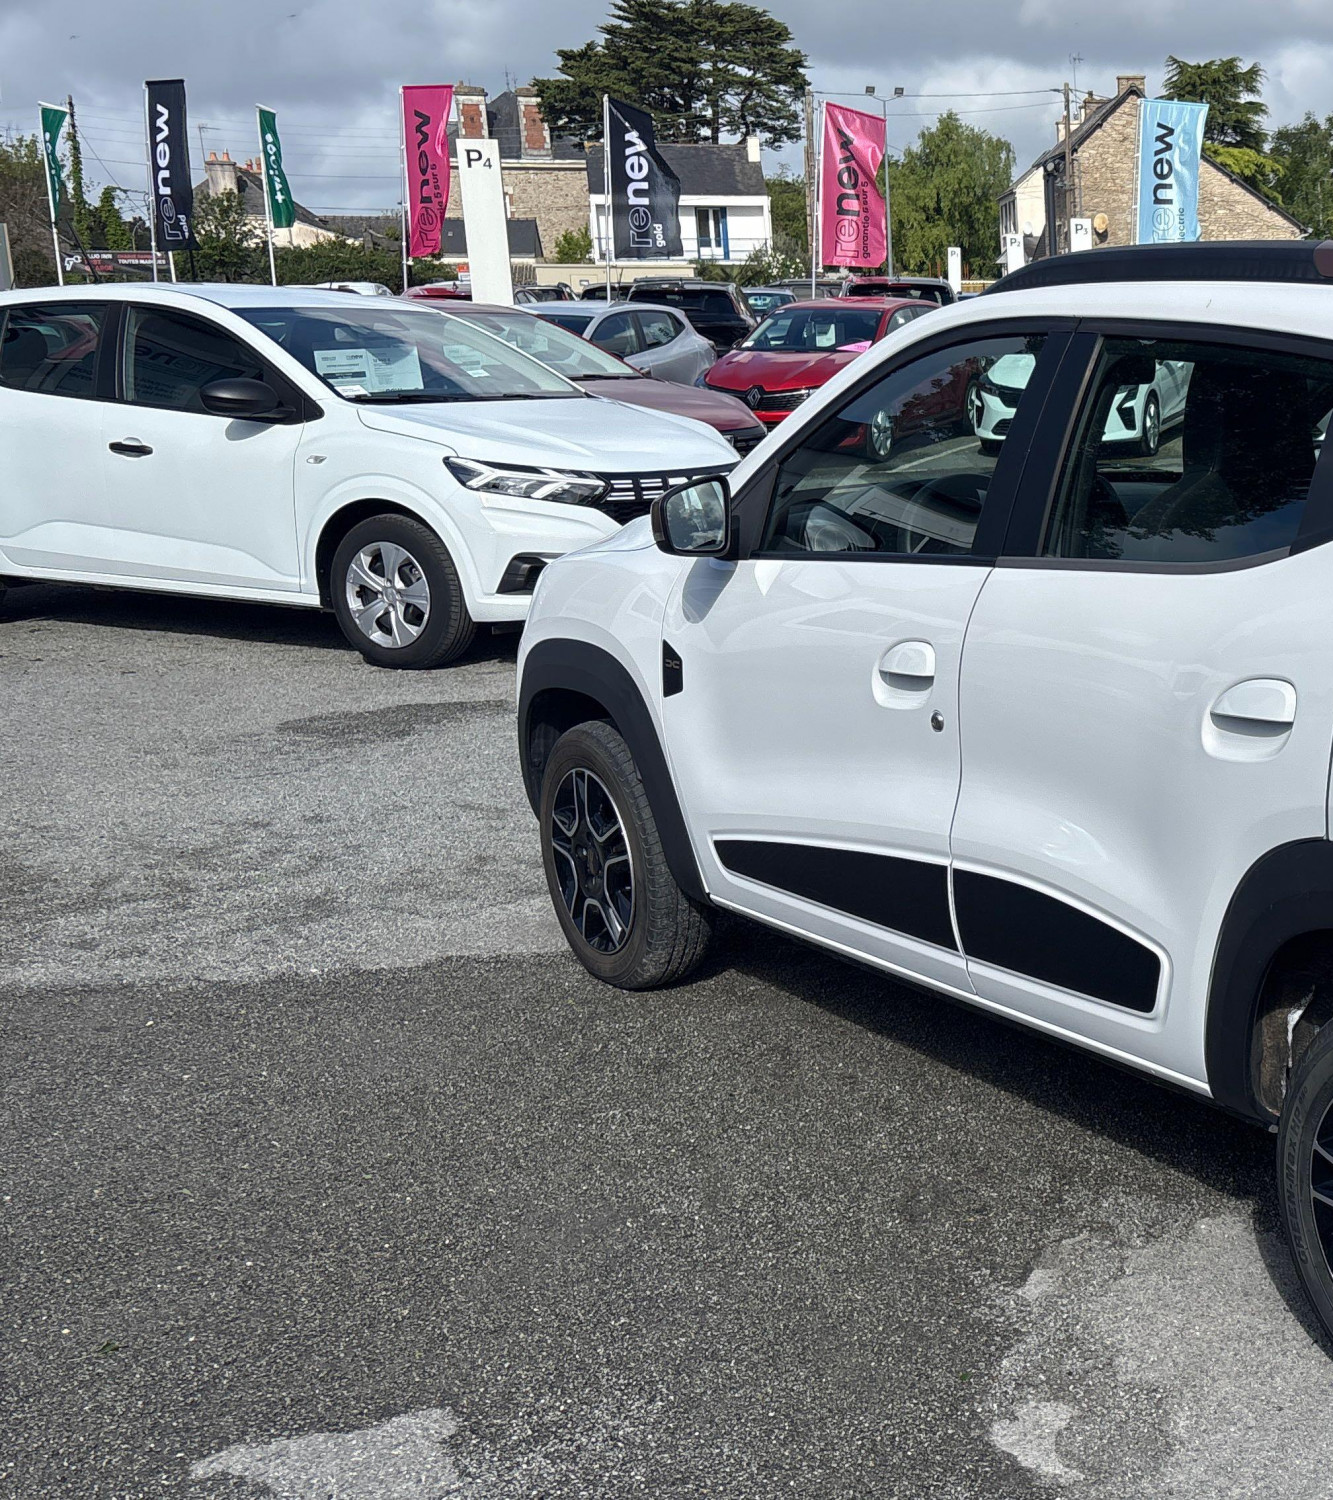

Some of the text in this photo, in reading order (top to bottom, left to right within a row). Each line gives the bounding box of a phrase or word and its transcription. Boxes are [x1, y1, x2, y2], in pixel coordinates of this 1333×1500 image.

[155, 103, 183, 240] renew
[413, 109, 439, 248] renew
[465, 149, 493, 170] P4
[624, 130, 653, 248] renew
[834, 127, 860, 259] renew
[653, 223, 667, 248] gold
[1074, 223, 1088, 235] P3
[1176, 207, 1186, 240] lectric
